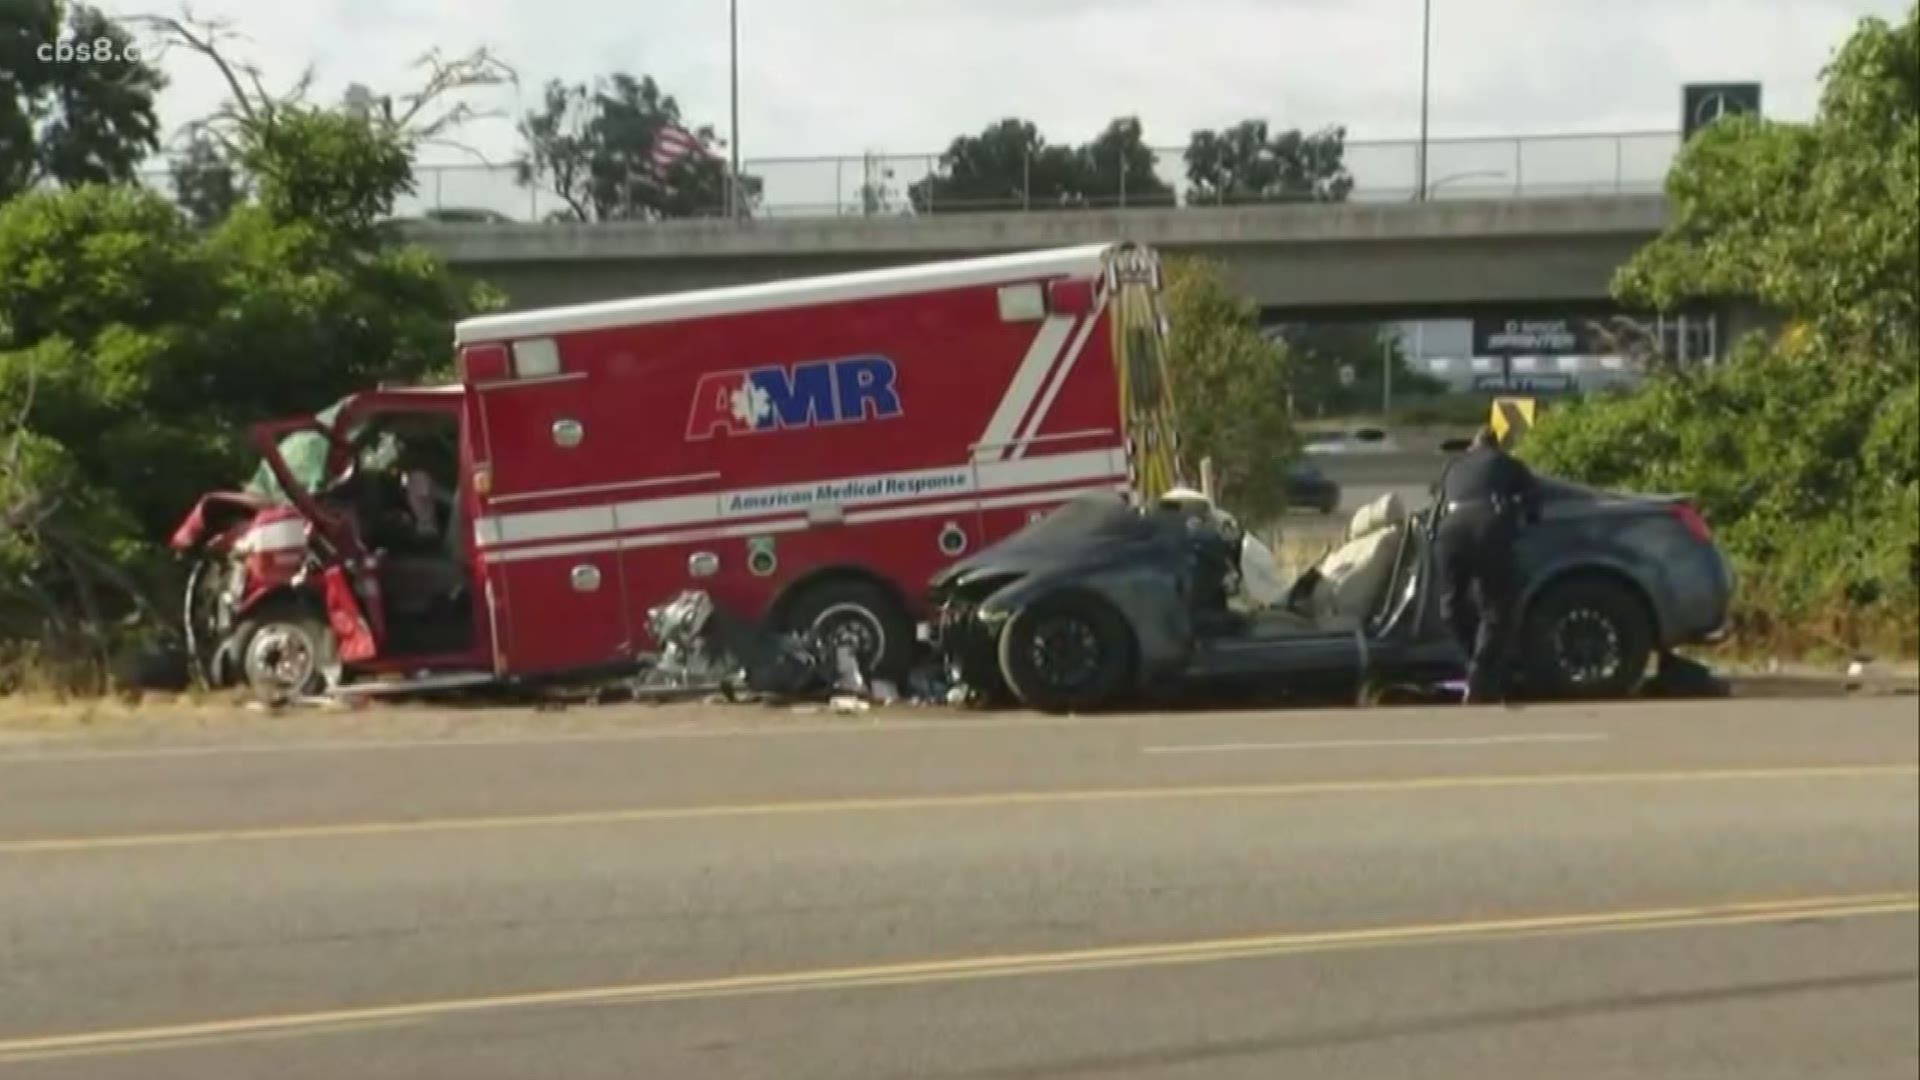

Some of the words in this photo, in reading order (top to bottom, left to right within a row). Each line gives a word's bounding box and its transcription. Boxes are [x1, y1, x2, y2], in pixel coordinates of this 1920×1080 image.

[685, 354, 904, 441] AMR
[730, 490, 813, 512] American
[816, 480, 883, 501] Medical
[886, 473, 967, 494] Response
